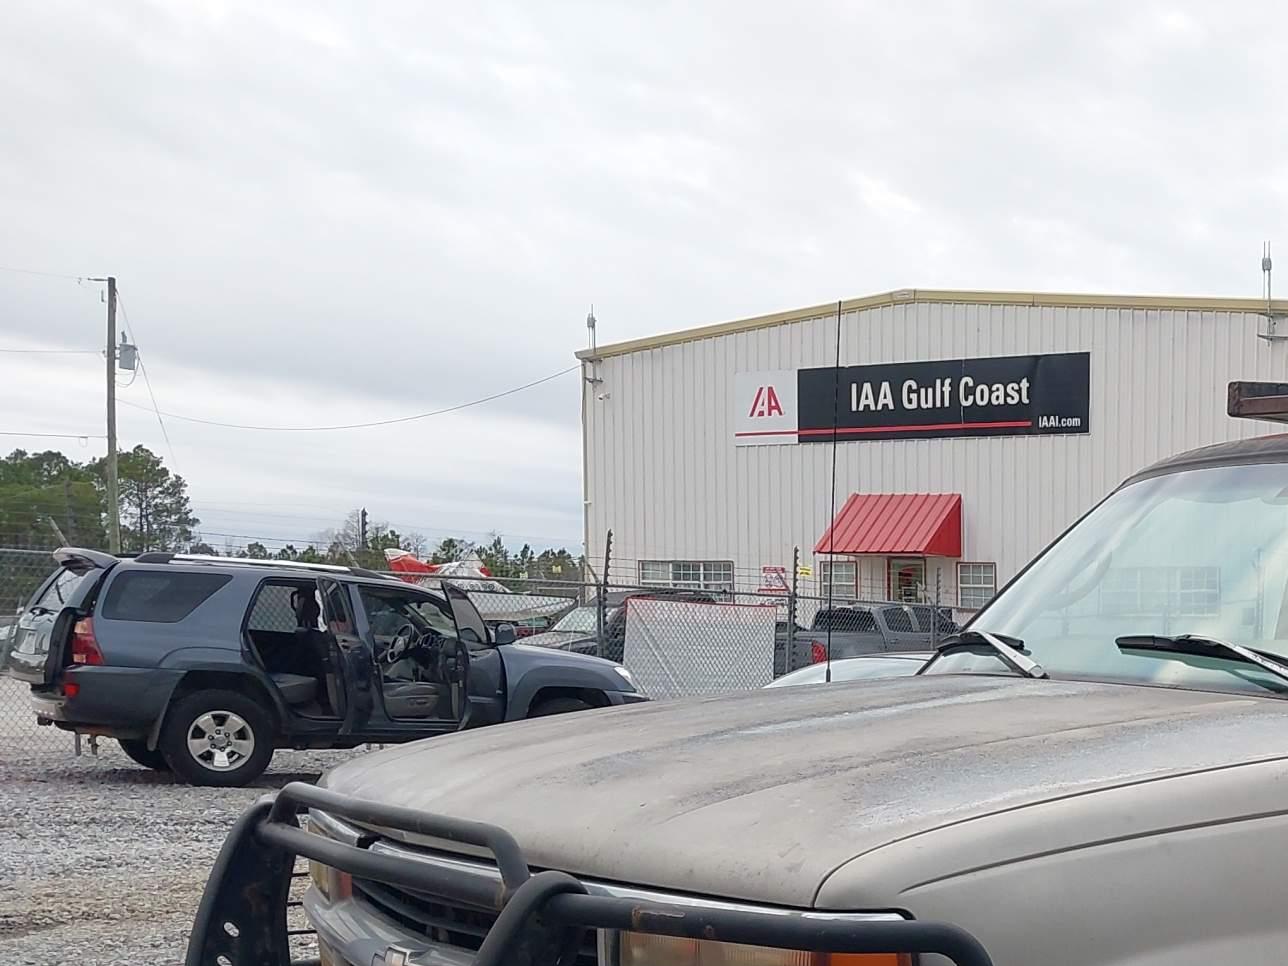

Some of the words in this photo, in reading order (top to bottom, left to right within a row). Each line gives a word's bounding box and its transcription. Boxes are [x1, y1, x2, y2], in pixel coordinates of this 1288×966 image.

[851, 381, 895, 412] IAA
[902, 378, 952, 409] Gulf
[959, 376, 1030, 407] Coast
[1038, 415, 1081, 428] IAAI.com
